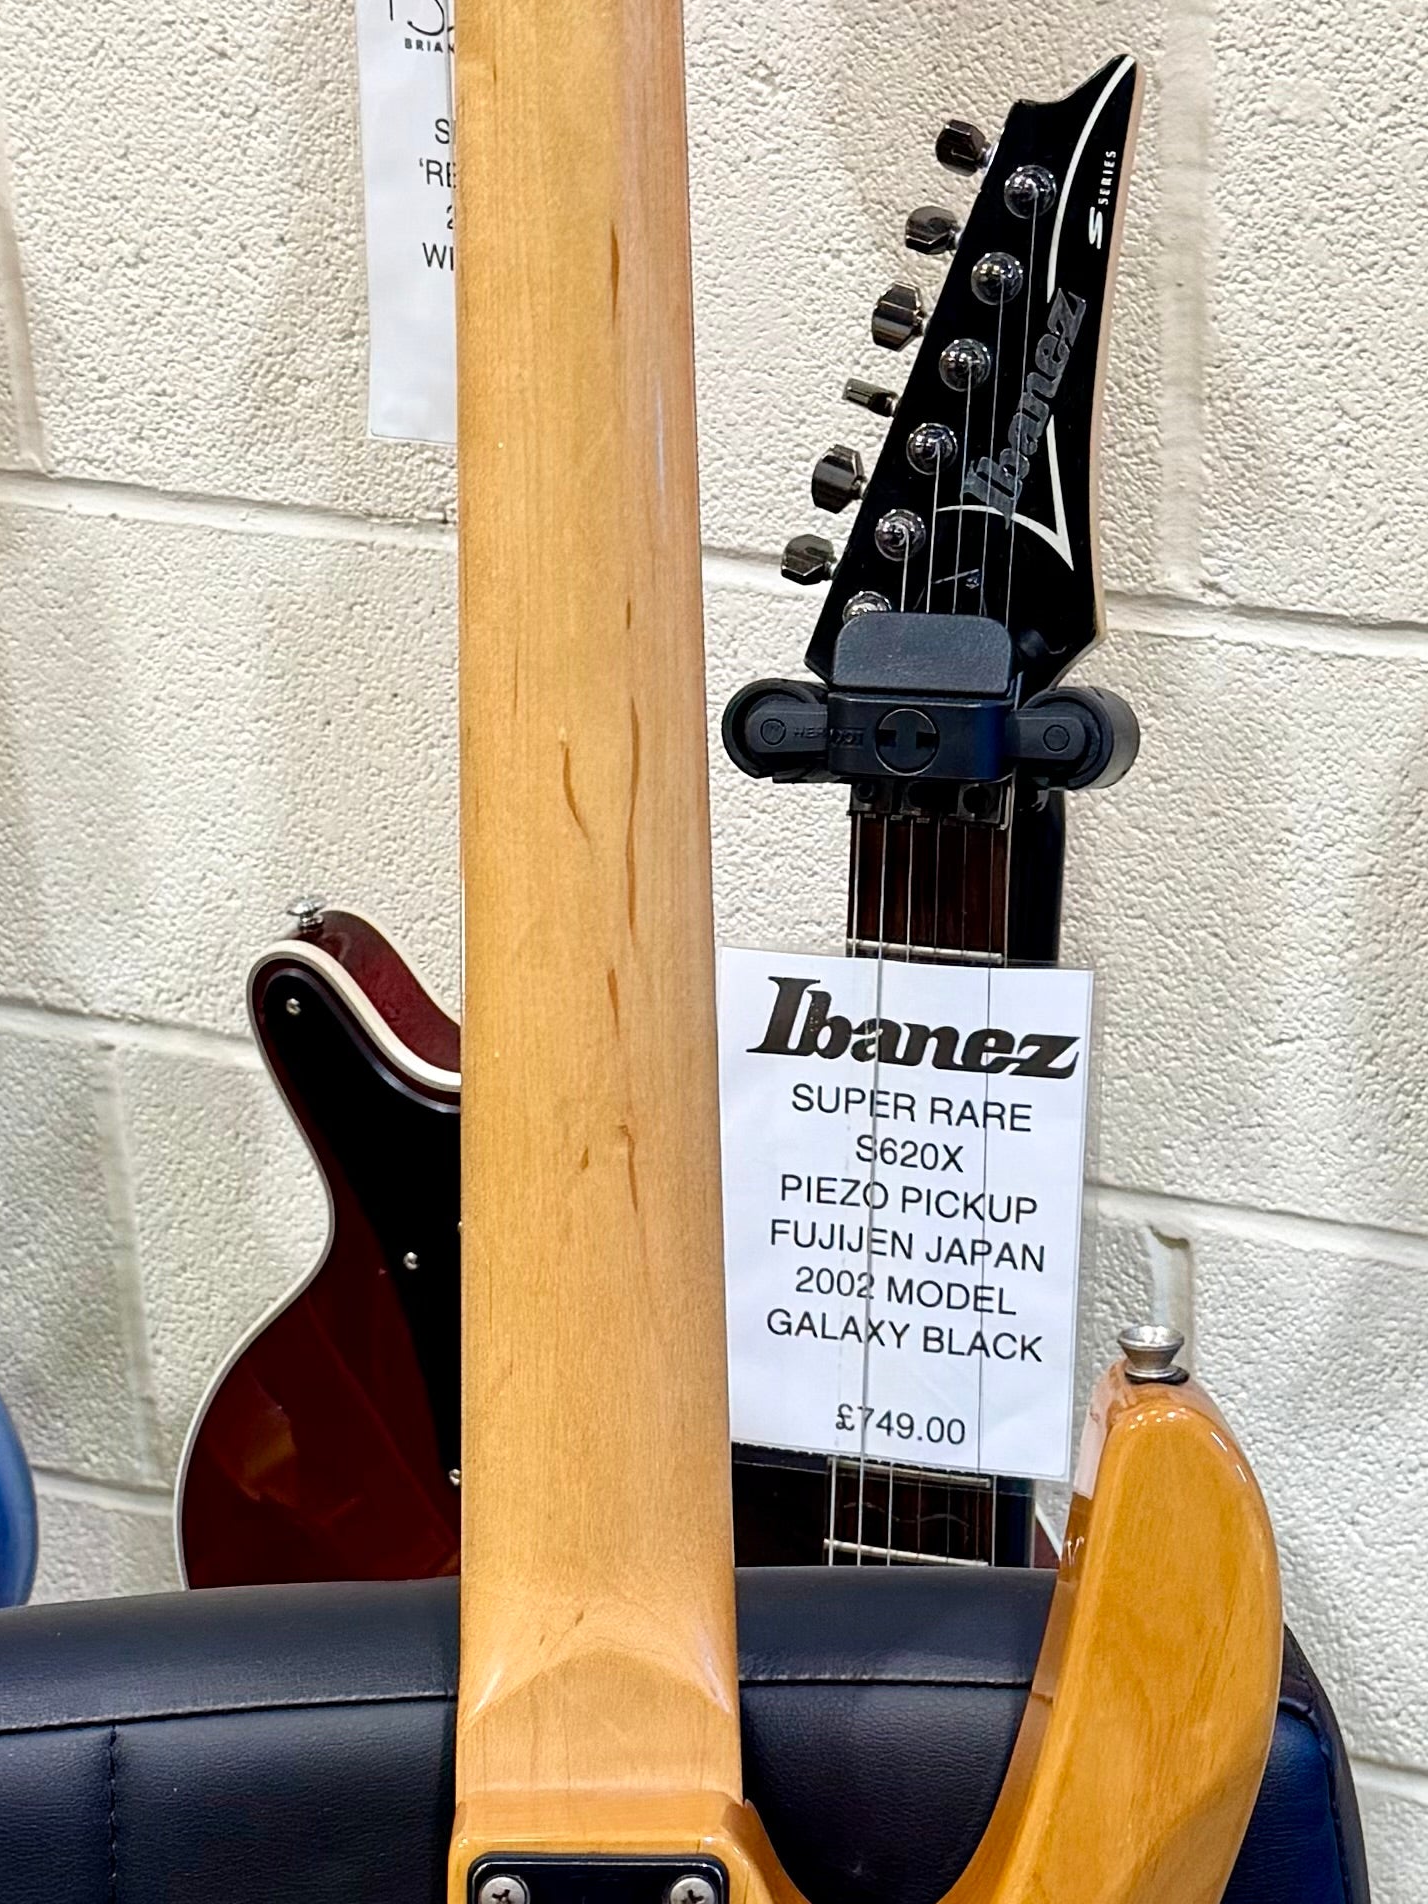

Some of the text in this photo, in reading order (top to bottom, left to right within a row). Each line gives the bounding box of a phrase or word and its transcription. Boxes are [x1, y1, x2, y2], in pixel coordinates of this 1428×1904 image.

[1098, 151, 1116, 205] SERIES
[960, 288, 1086, 530] Ibanez
[746, 975, 1082, 1080] Ibanez
[791, 1083, 1033, 1133] SUPER RARE
[855, 1135, 965, 1174] S620X
[780, 1174, 1038, 1225] PIEZO PICKUP
[770, 1218, 1045, 1273] FUJIJEN JAPAN
[795, 1266, 1017, 1316] 2002 MODEL
[766, 1308, 1044, 1363] GALAXY BLACK
[835, 1403, 966, 1445] £749.00
